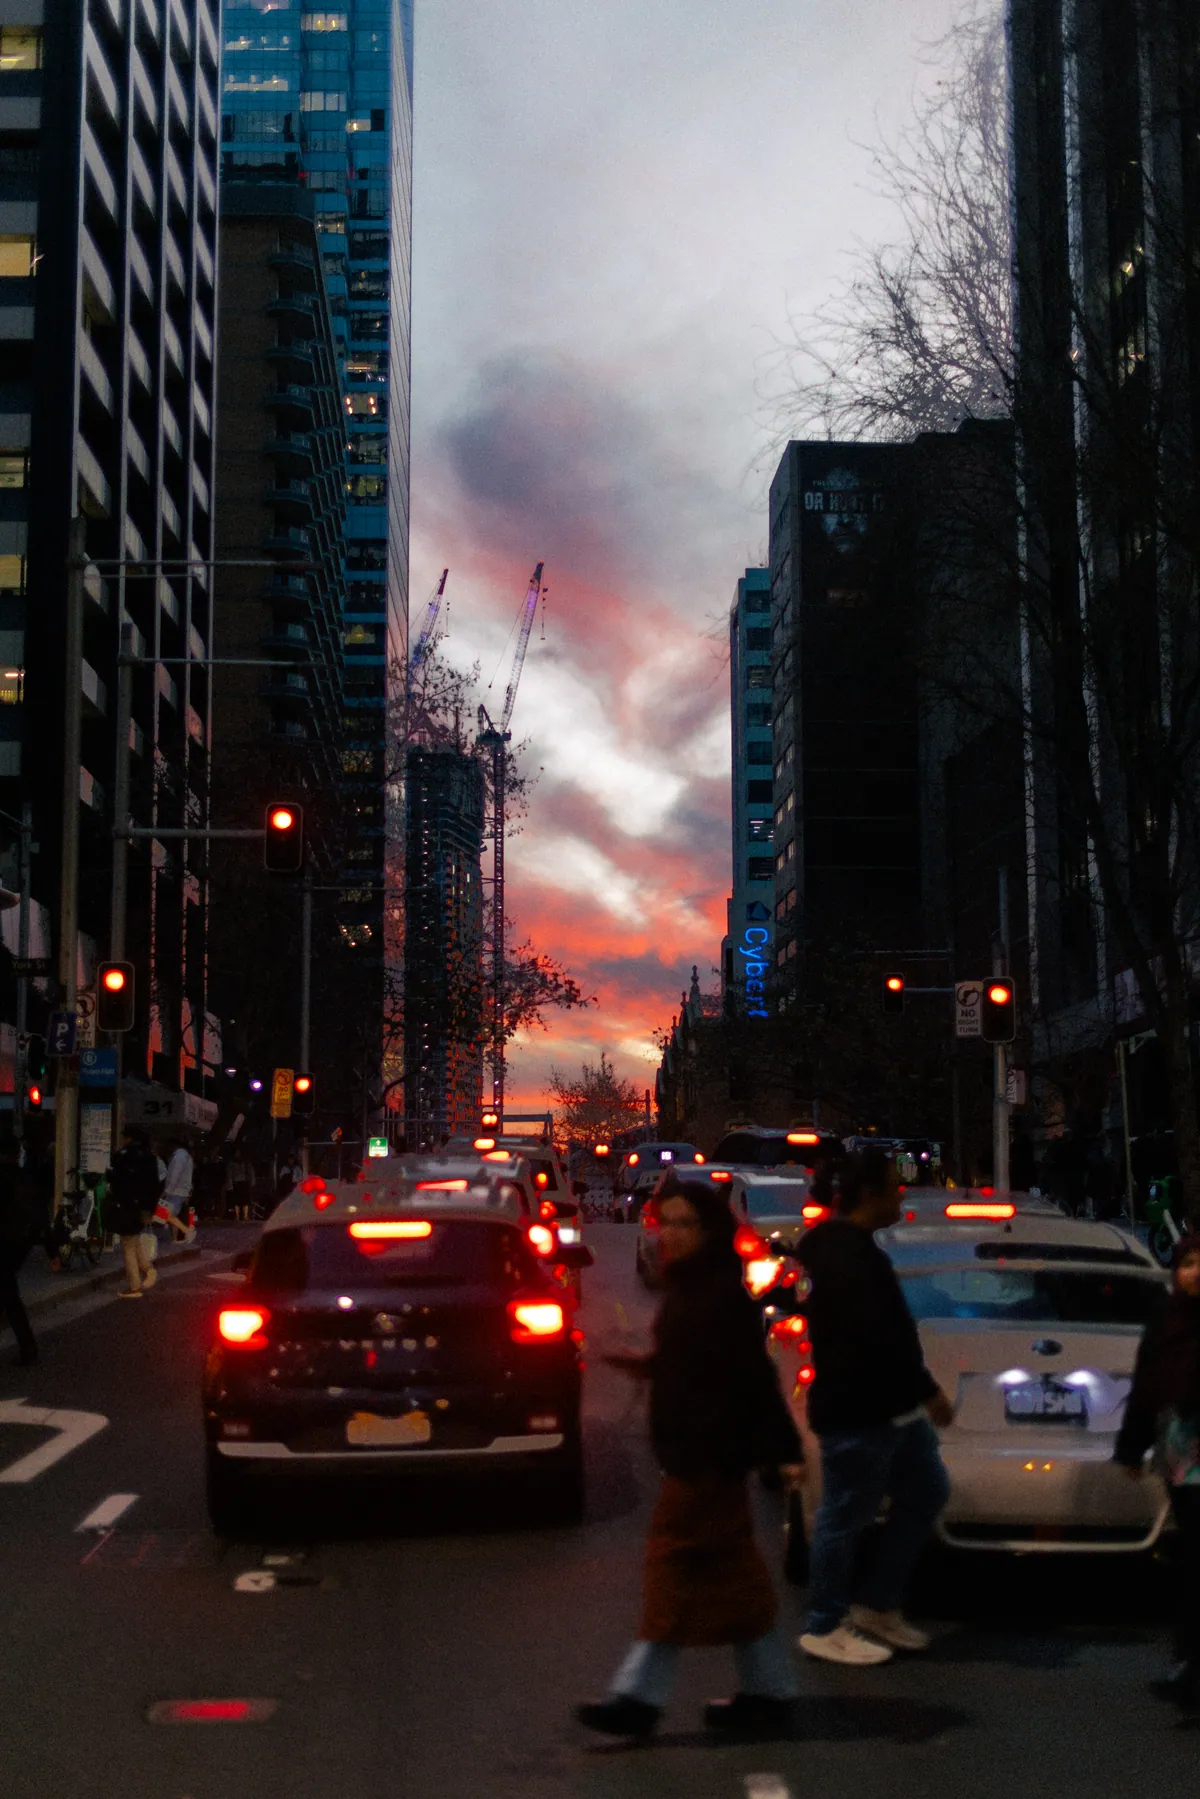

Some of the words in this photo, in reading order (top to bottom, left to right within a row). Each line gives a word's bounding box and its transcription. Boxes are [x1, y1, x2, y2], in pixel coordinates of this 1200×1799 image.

[804, 491, 823, 511] OR
[960, 1009, 976, 1017] NO
[57, 1022, 69, 1037] P
[145, 1101, 172, 1114] 31
